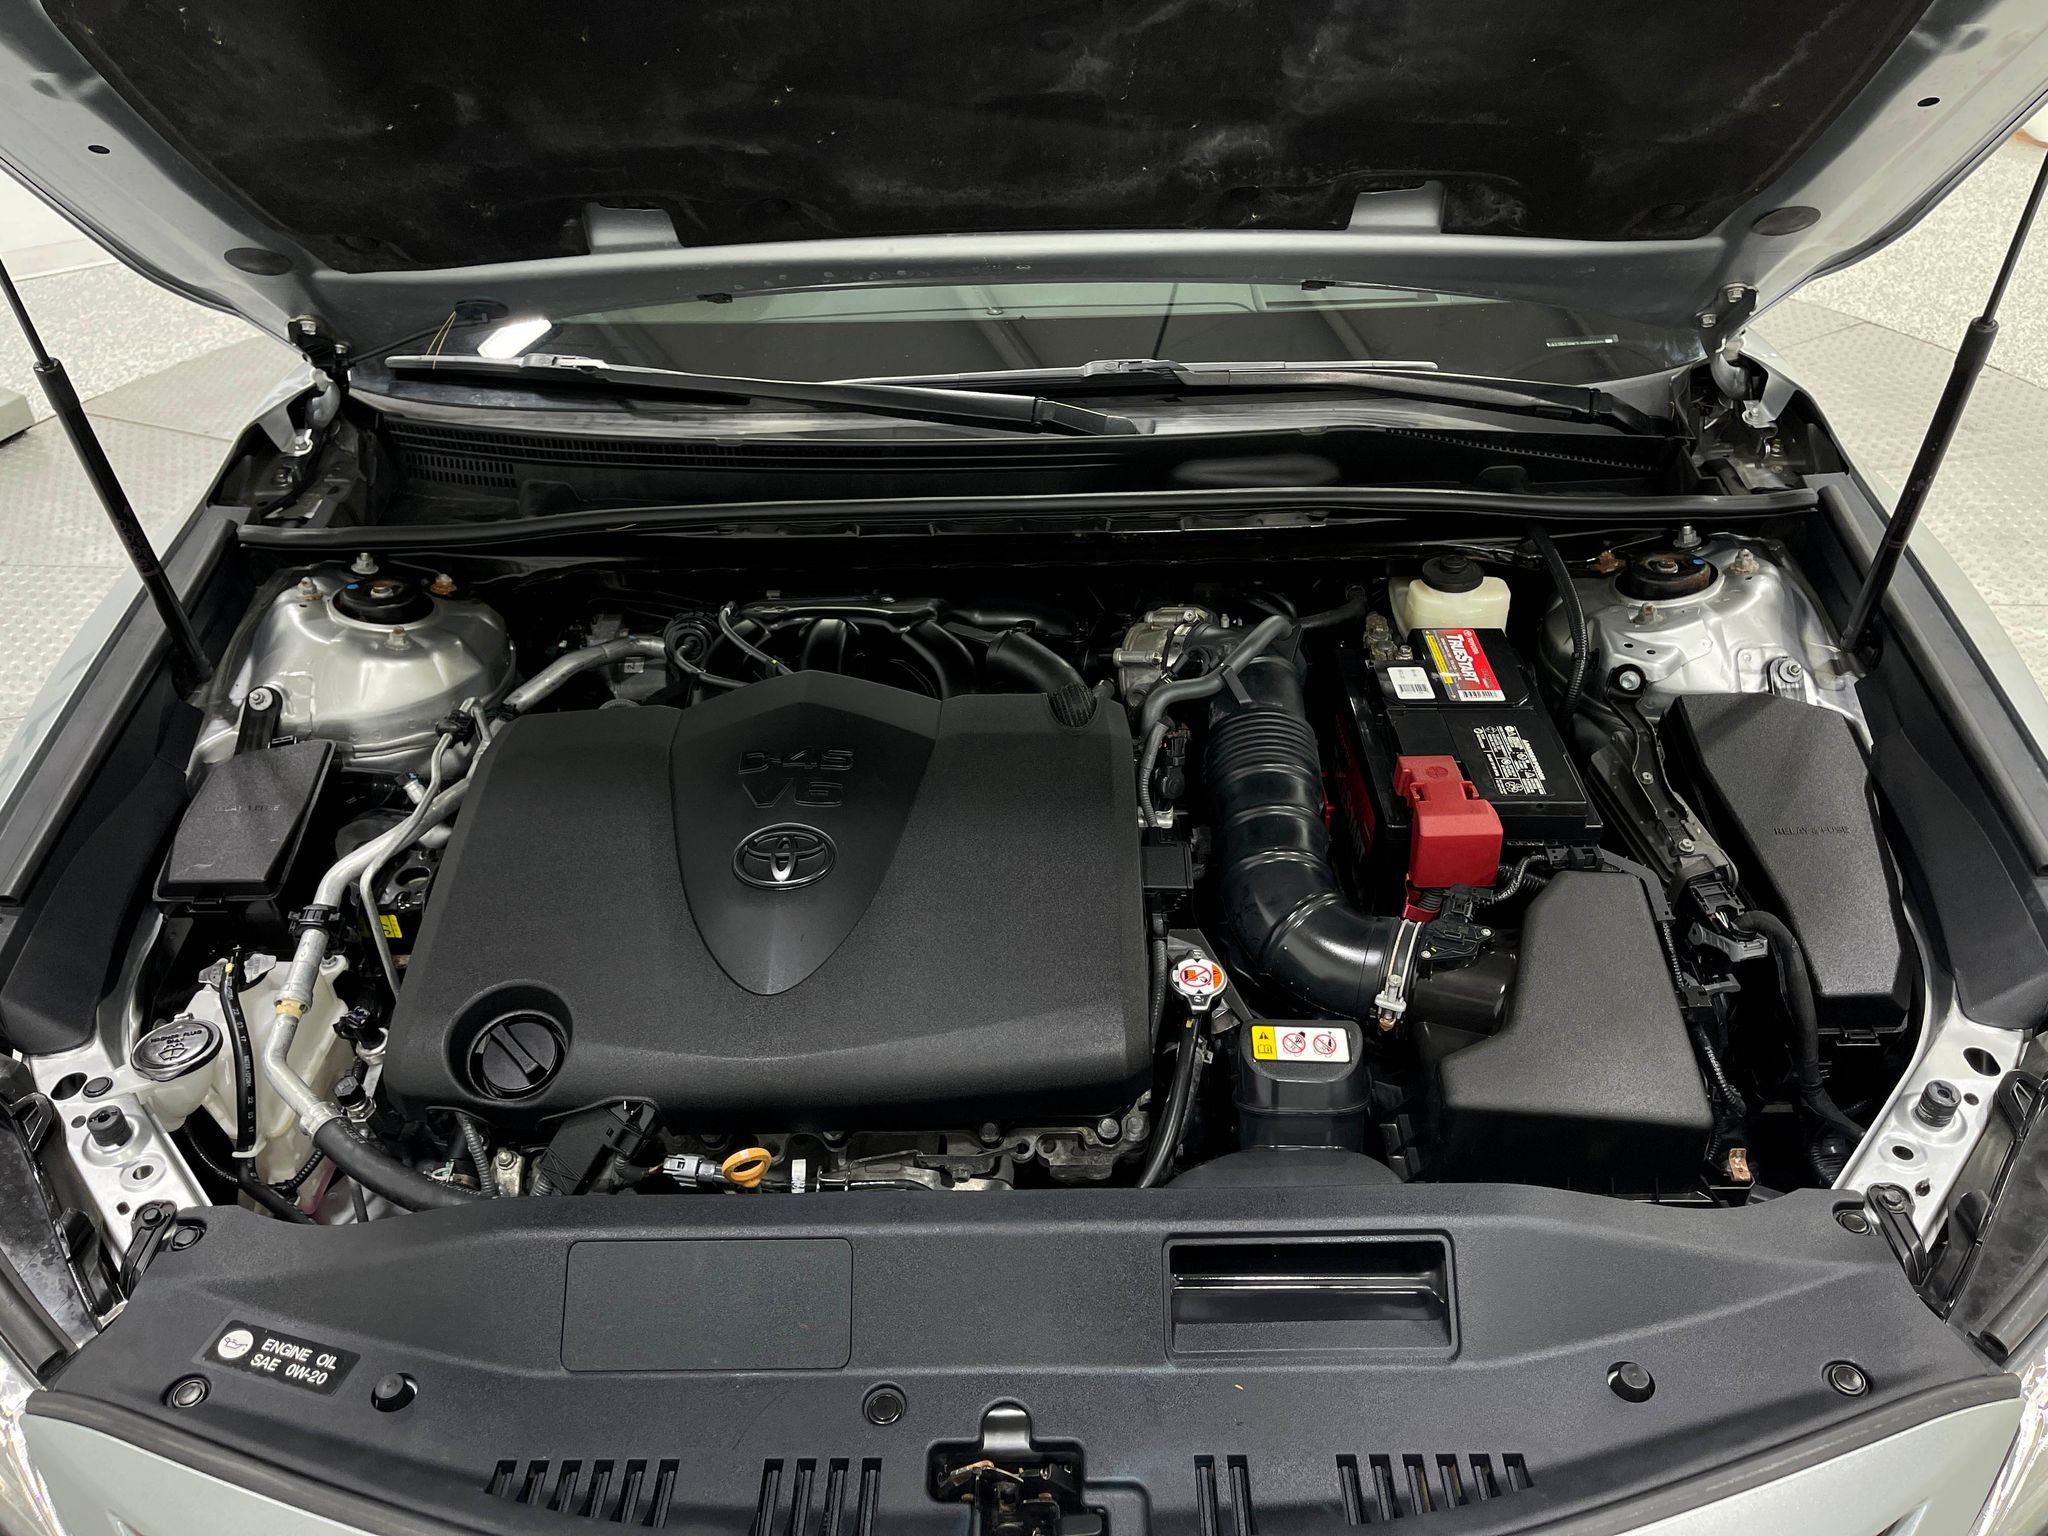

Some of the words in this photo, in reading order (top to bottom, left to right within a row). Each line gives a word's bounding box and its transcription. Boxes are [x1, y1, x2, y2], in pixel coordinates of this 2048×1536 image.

[1466, 637, 1480, 655] TOYOTA
[738, 748, 854, 774] D-4S
[741, 777, 844, 808] V6
[250, 1353, 282, 1371] SAE
[285, 1363, 328, 1385] 0W-20
[261, 1338, 313, 1362] ENGINE
[316, 1353, 337, 1370] OIL
